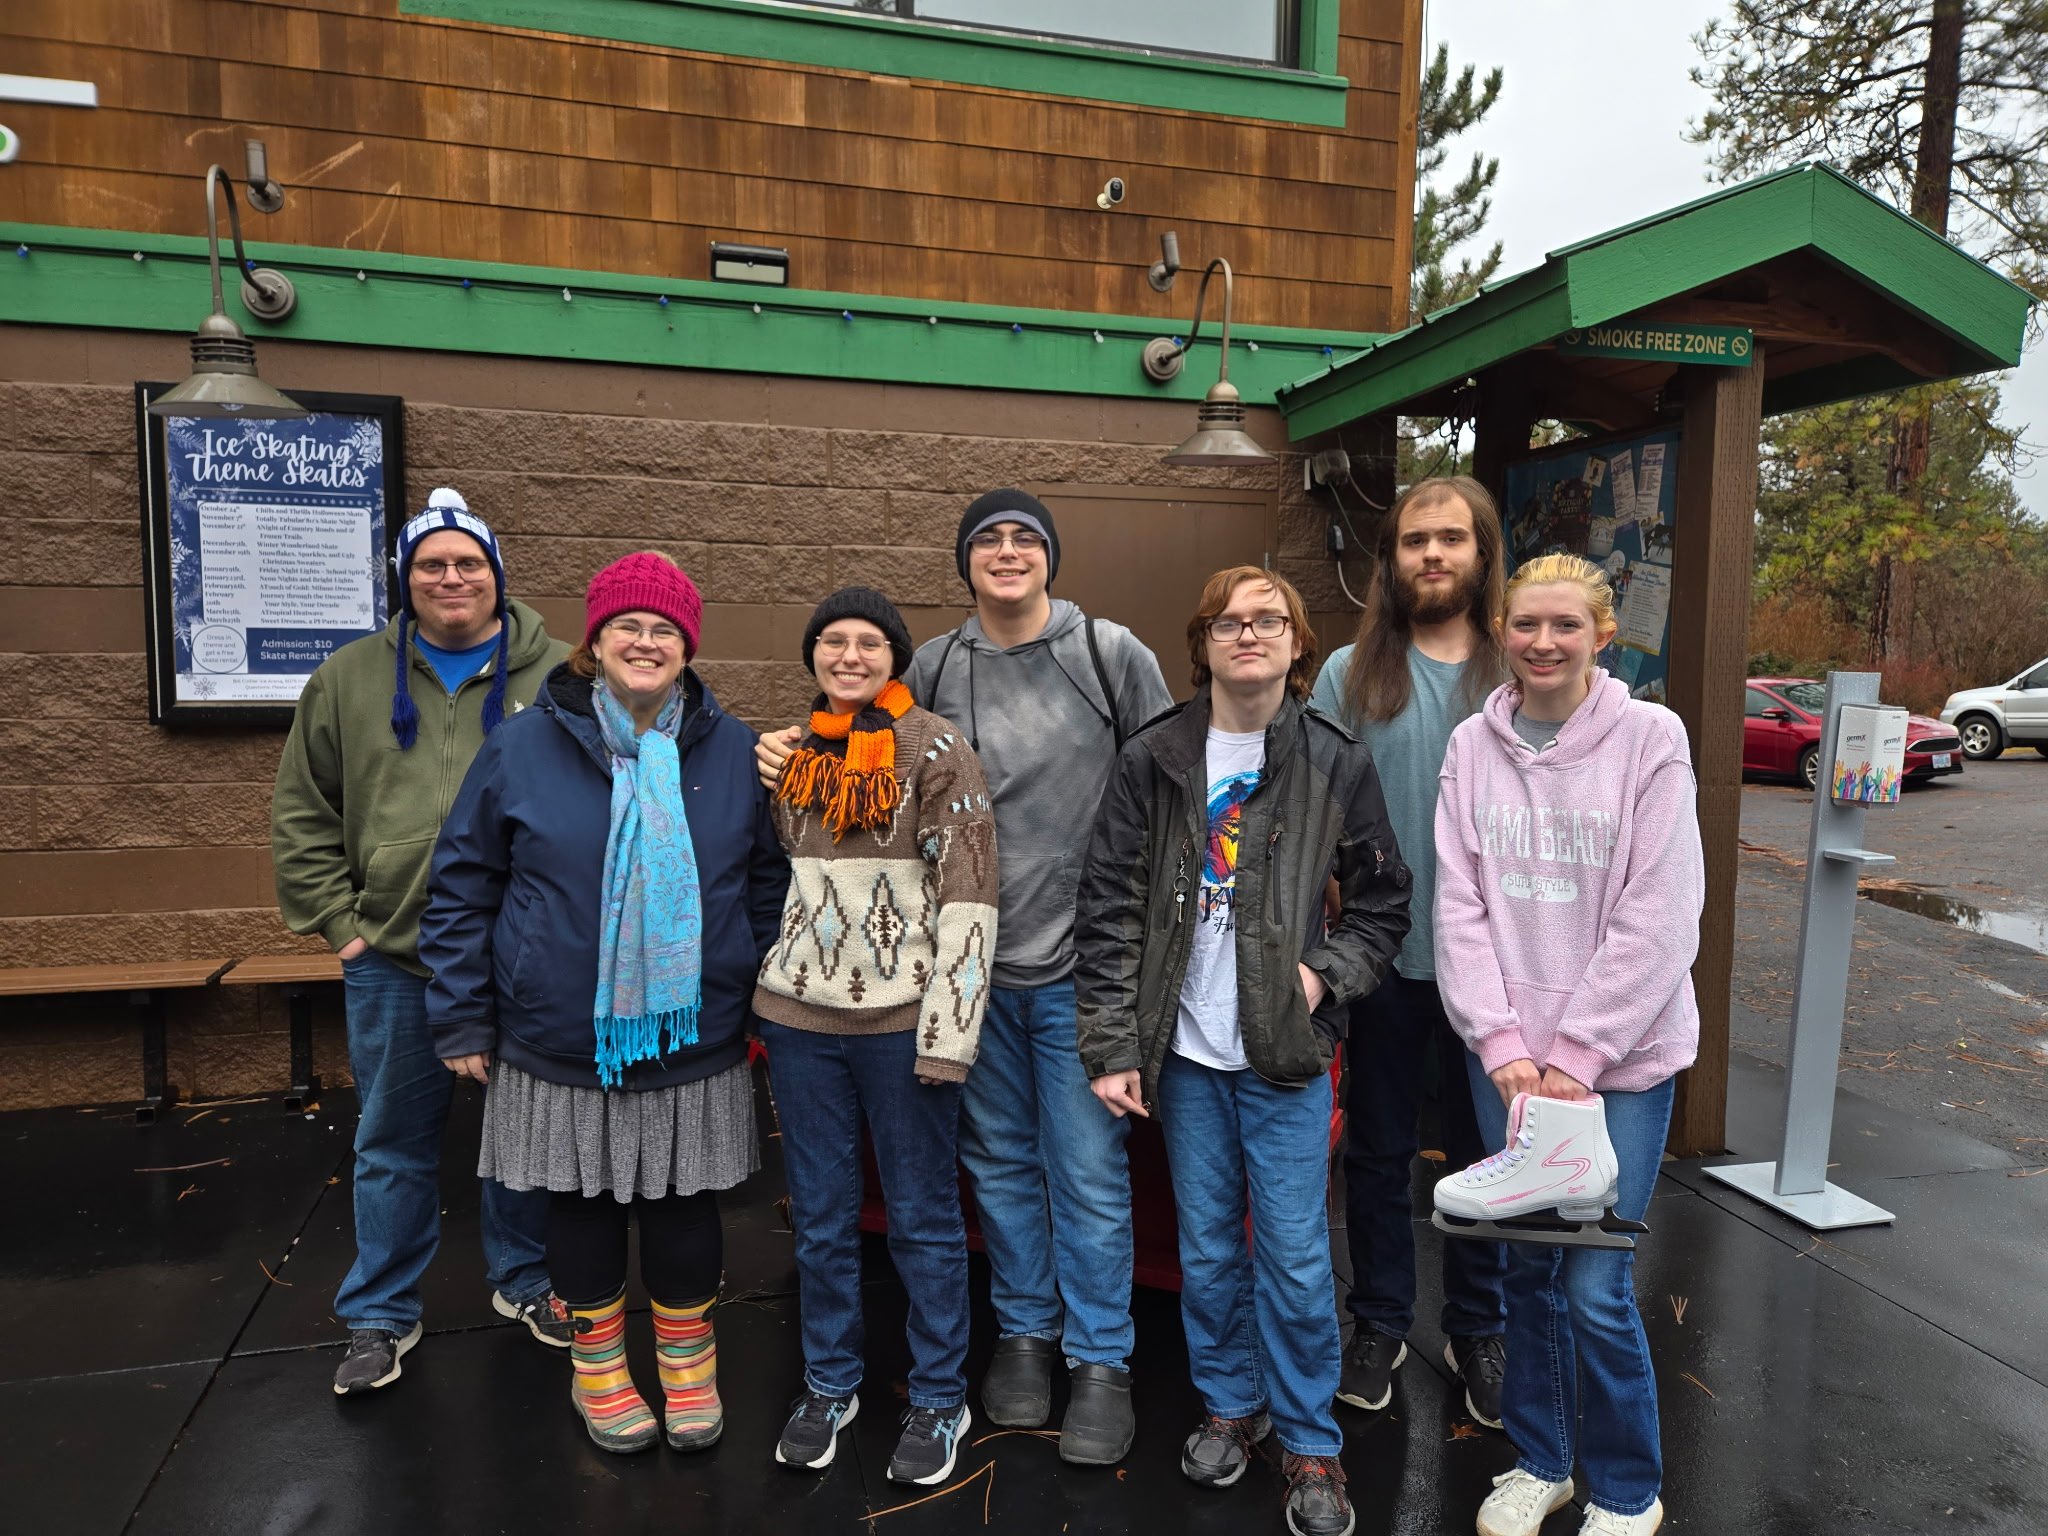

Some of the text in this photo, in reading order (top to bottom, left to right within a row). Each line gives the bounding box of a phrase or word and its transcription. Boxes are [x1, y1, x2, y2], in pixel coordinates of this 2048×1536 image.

[1587, 327, 1726, 355] SMOKE FREE ZONE
[201, 429, 353, 467] Ice Skating
[185, 453, 368, 488] Theme Skates
[256, 515, 277, 523] Totally
[281, 567, 298, 575] Night
[205, 591, 234, 599] February
[261, 640, 333, 649] Admission: $10
[260, 651, 287, 660] Skate
[288, 651, 321, 660] Rental:
[1535, 877, 1571, 892] STYLE
